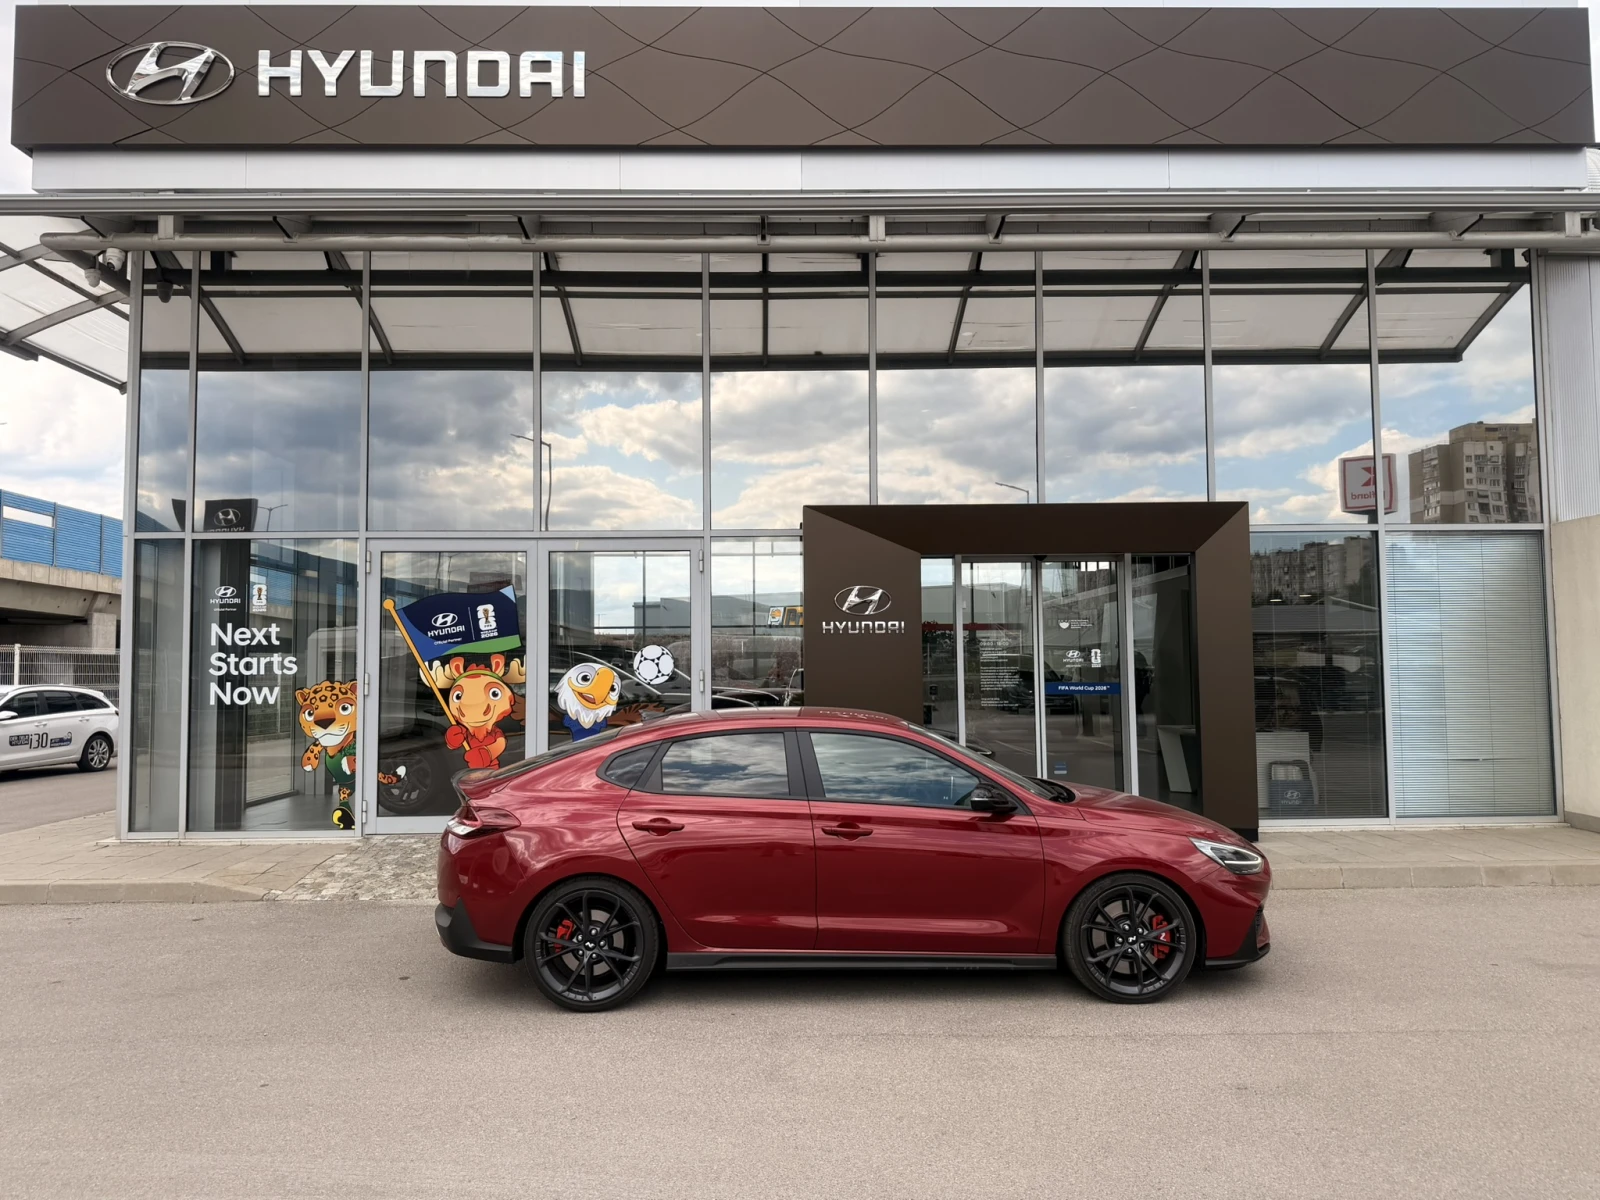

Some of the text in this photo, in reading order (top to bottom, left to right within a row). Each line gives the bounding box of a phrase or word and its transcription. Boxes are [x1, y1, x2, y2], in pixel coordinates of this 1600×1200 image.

[258, 50, 585, 97] HYUNDAI
[211, 623, 280, 646] Next
[428, 625, 466, 637] HYUNDAI
[822, 621, 905, 634] HYUNDAI
[208, 652, 298, 676] Starts
[209, 682, 280, 705] Now
[29, 732, 48, 749] i30
